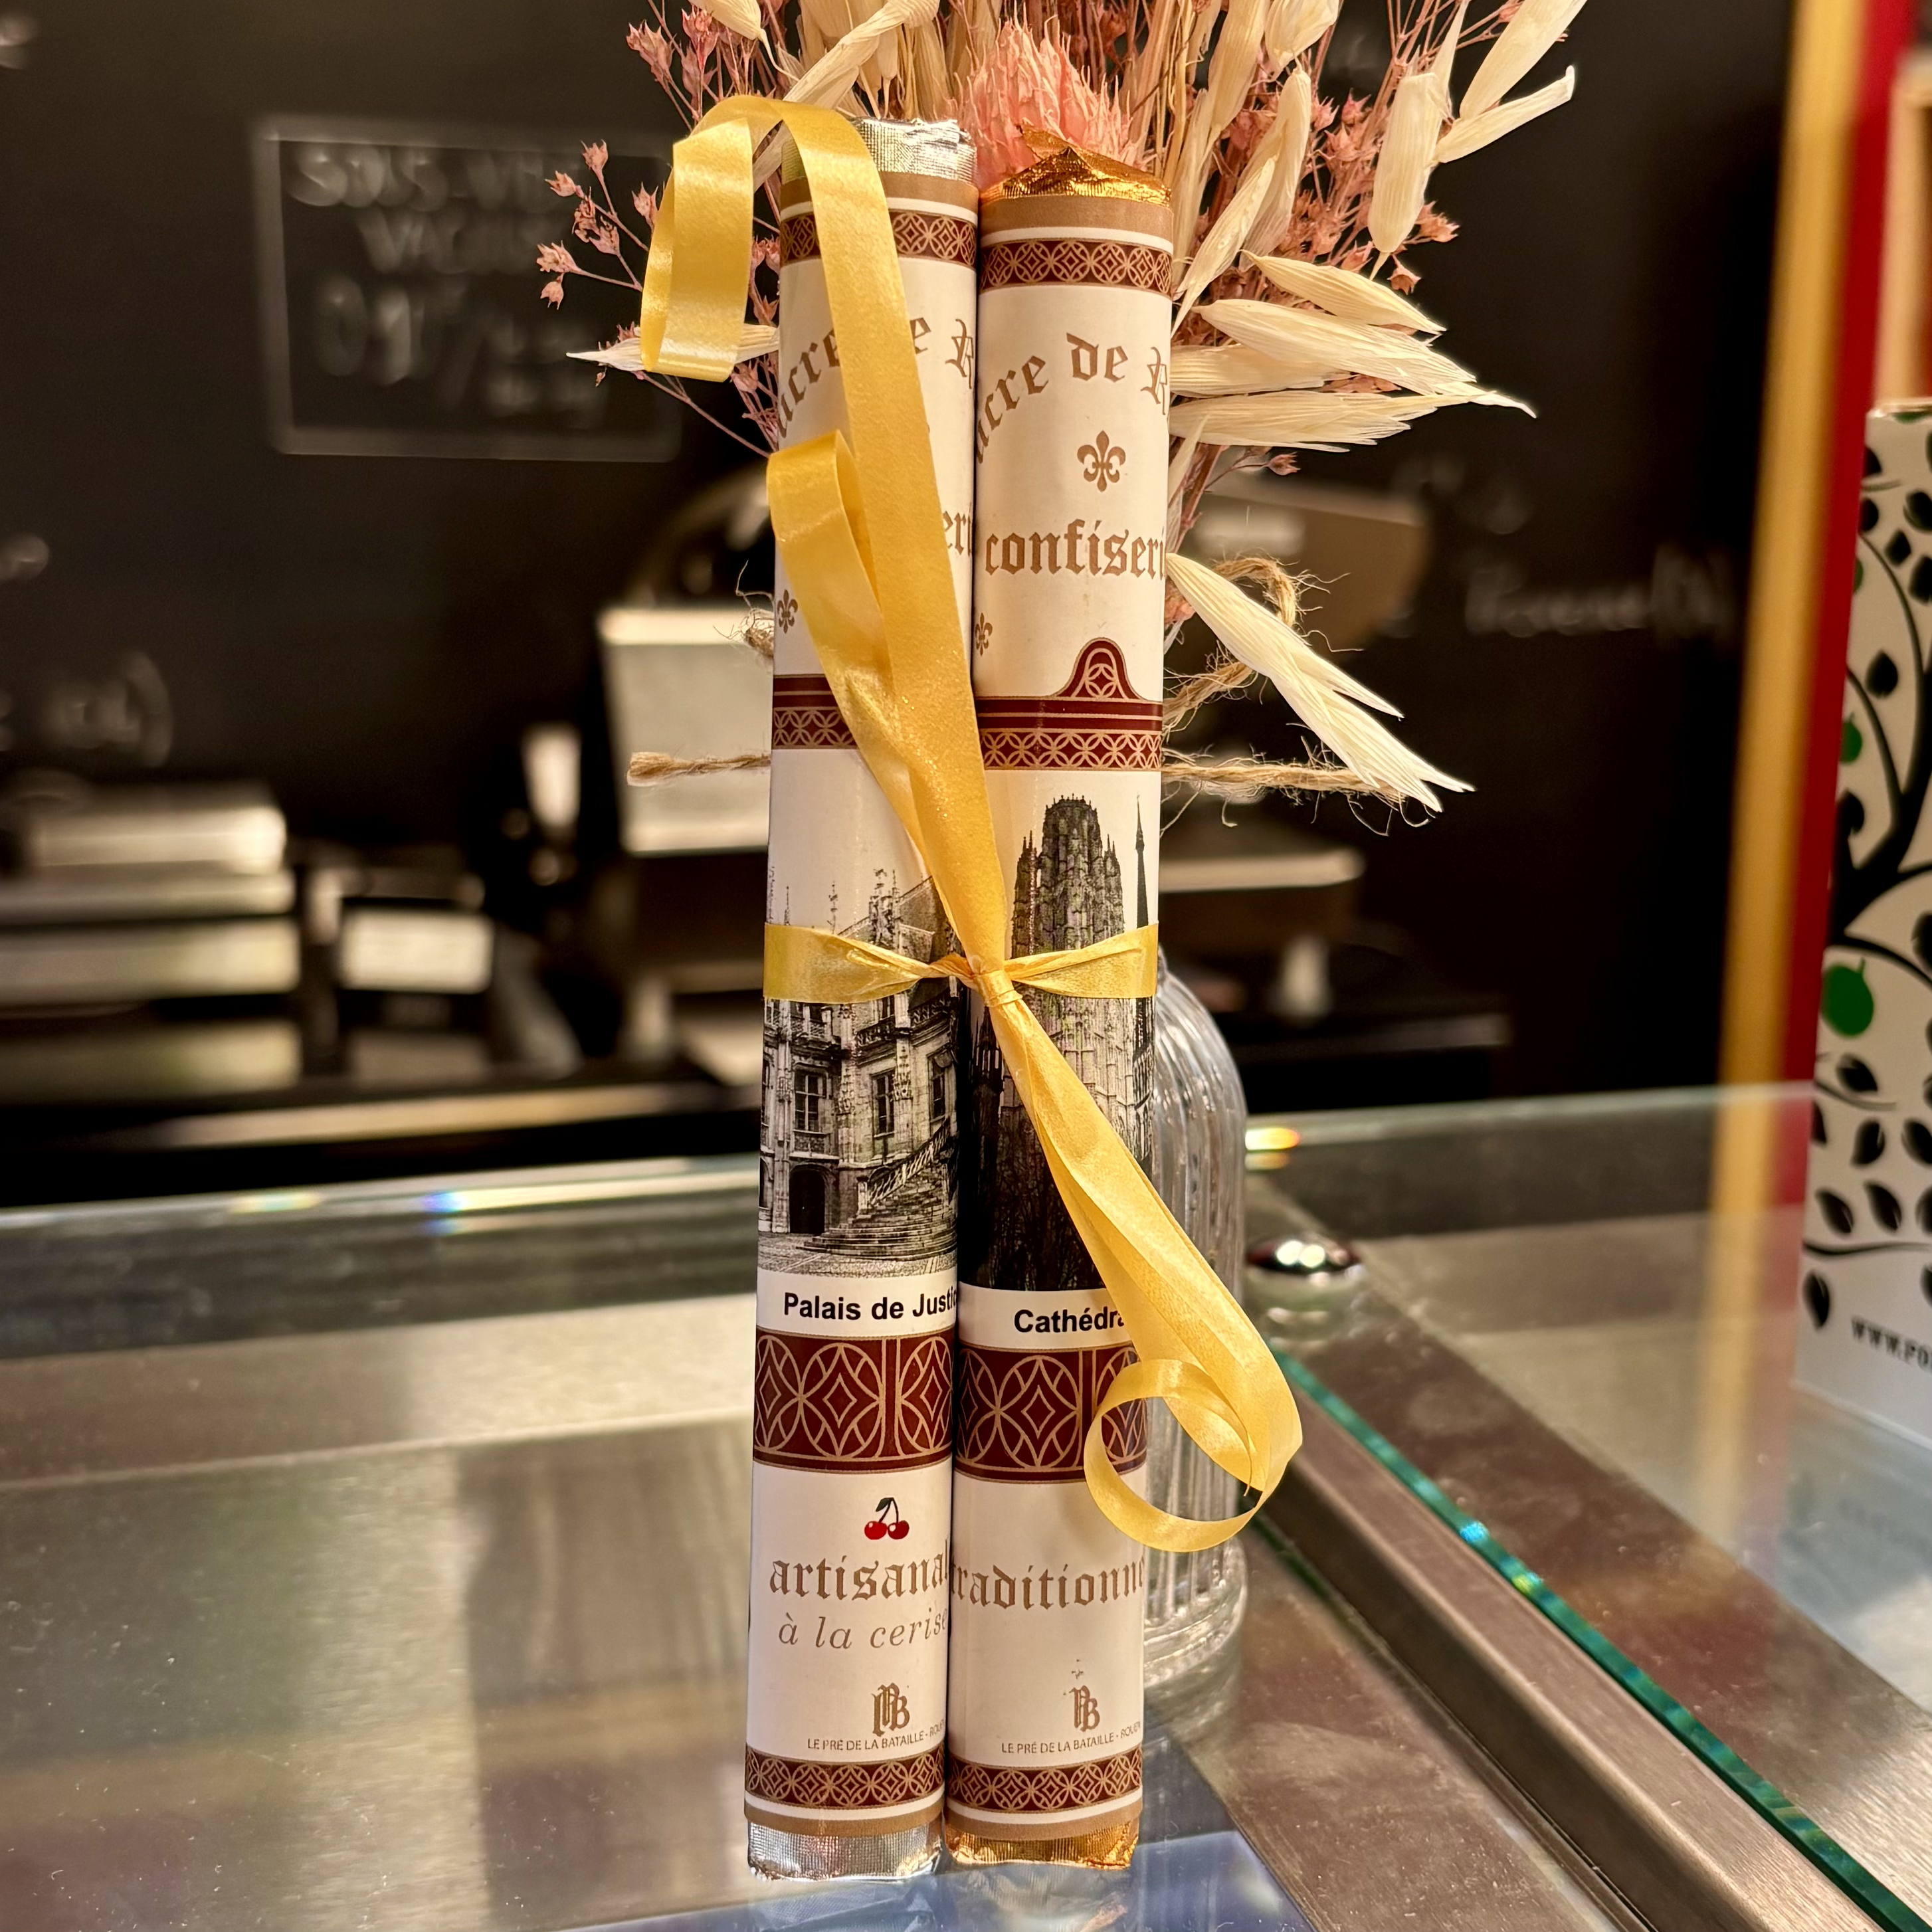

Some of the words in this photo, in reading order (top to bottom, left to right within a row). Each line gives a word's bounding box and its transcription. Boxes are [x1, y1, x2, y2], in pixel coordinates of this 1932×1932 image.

[1066, 332, 1129, 383] de
[784, 1292, 862, 1321] Palais
[871, 1296, 904, 1320] de
[778, 1612, 799, 1646] à
[815, 1616, 852, 1650] la
[807, 1738, 820, 1750] LE
[846, 1740, 862, 1751] DE
[865, 1739, 878, 1750] LA
[882, 1730, 924, 1749] BATAILLE
[1002, 1742, 1014, 1753] LE
[1017, 1741, 1038, 1754] PRÉ
[1040, 1743, 1055, 1753] DE
[1058, 1741, 1072, 1753] LA
[1074, 1732, 1115, 1750] BATAILLE
